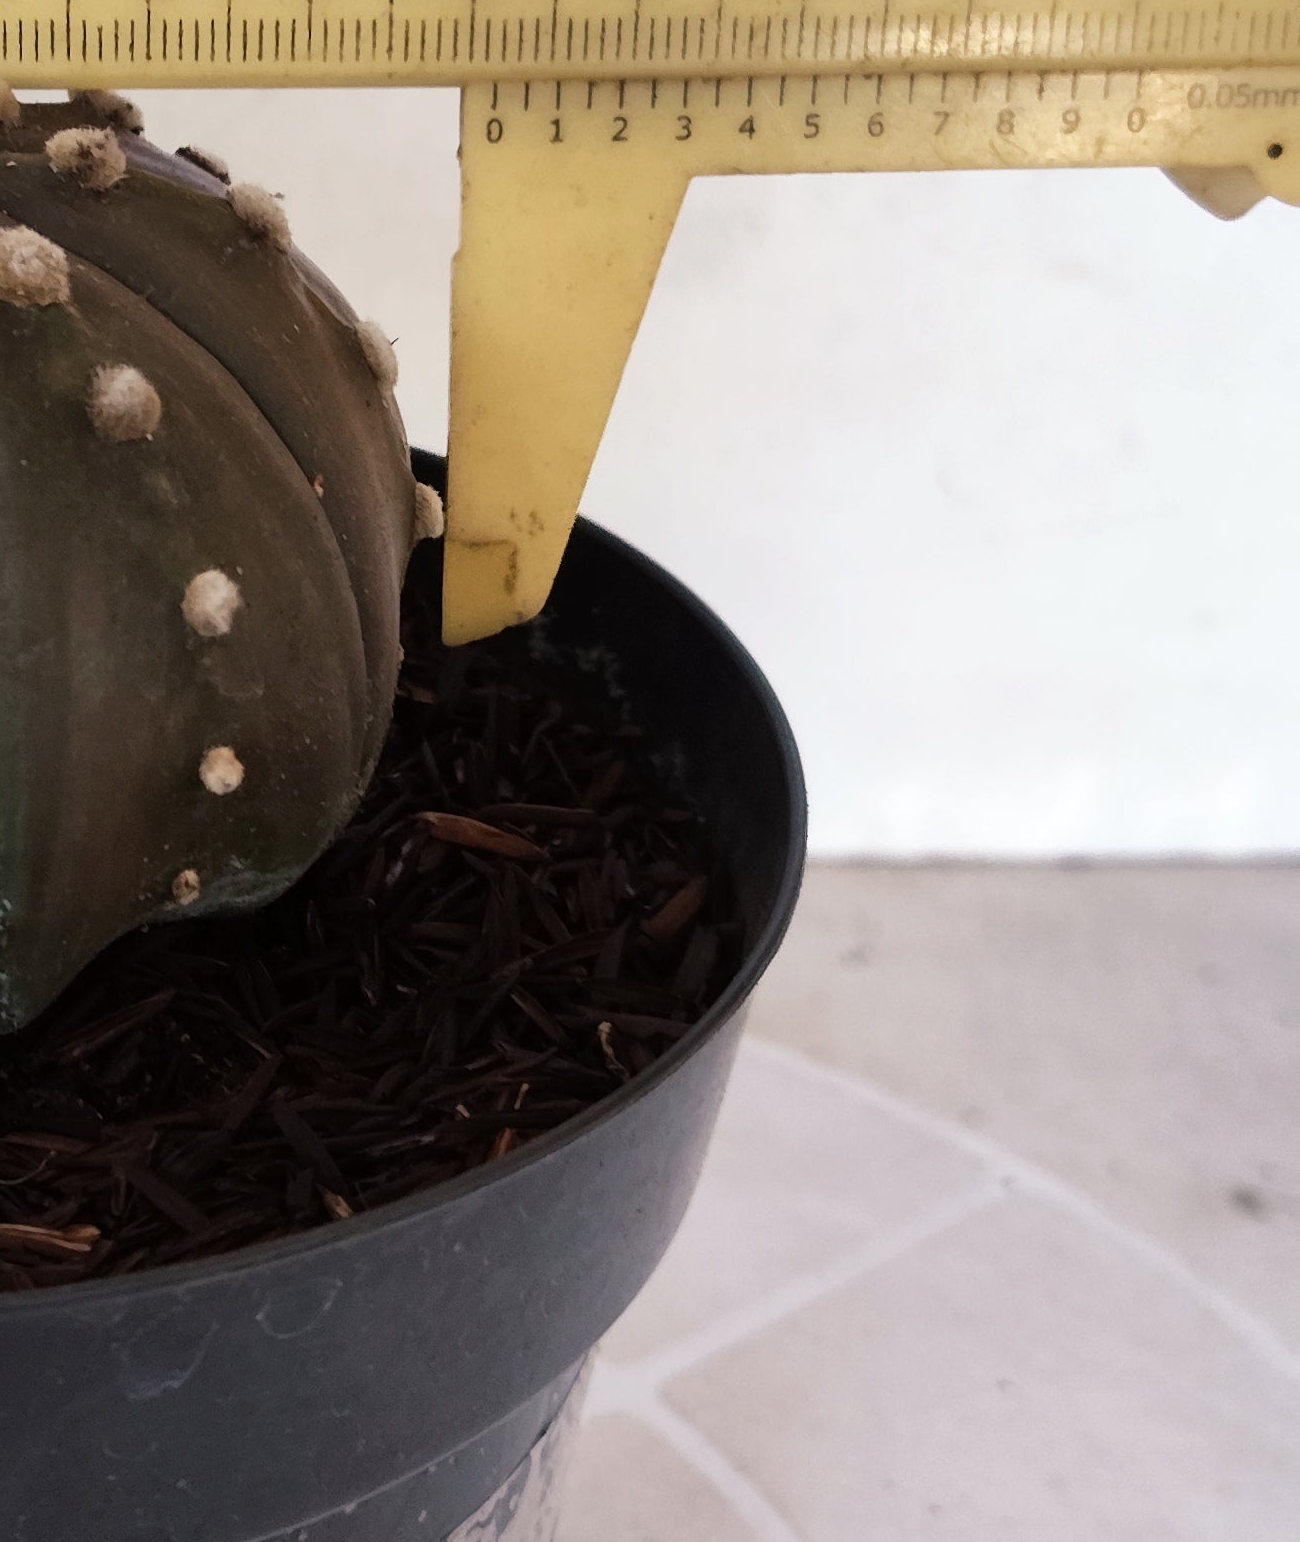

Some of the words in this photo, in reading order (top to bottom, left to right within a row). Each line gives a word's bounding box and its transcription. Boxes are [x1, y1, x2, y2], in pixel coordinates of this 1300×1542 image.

[486, 118, 503, 144] 0
[550, 119, 564, 143] 1
[611, 117, 629, 143] 2
[675, 116, 693, 141] 3
[738, 115, 756, 140] 4
[803, 114, 820, 139] 5
[867, 113, 885, 138] 6
[933, 111, 950, 136] 7
[996, 110, 1016, 134] 8
[1061, 109, 1081, 134] 9
[1127, 108, 1146, 133] 0
